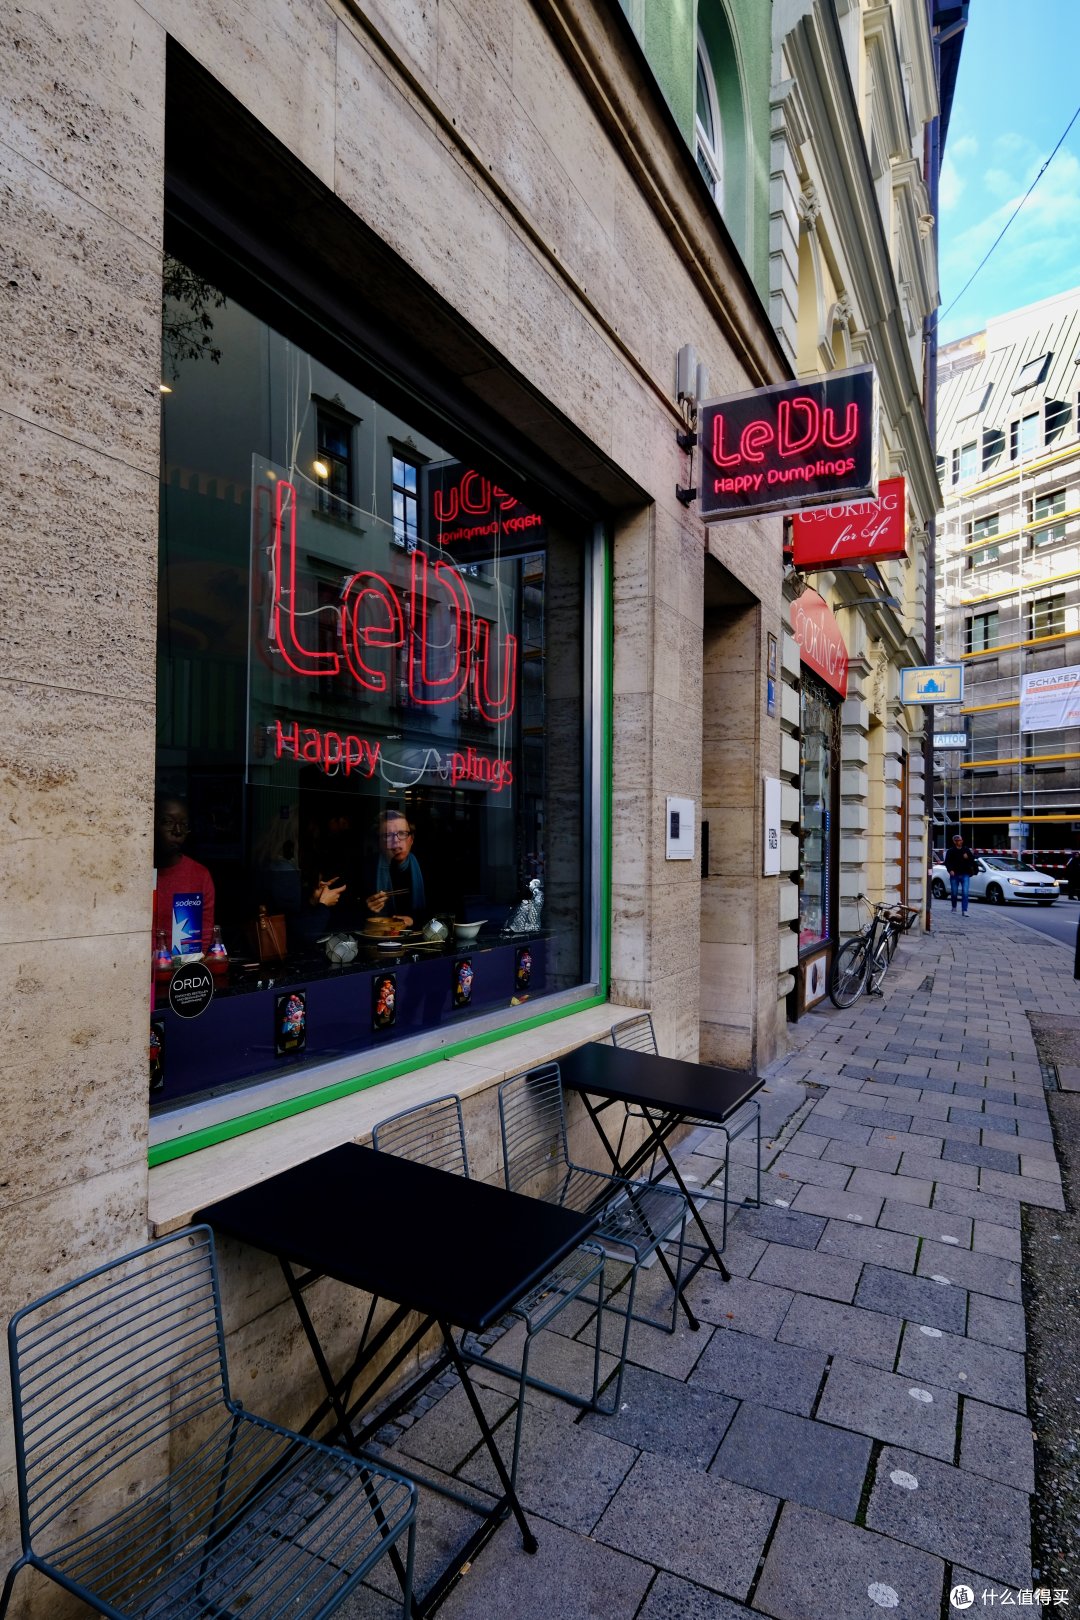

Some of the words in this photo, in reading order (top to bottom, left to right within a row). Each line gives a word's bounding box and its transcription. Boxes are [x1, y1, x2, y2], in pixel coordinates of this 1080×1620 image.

[713, 397, 858, 467] LeDu
[714, 473, 763, 494] Happy
[767, 458, 855, 485] Dumplings
[830, 524, 858, 555] for
[275, 480, 517, 722] LeDu
[275, 720, 380, 779] Happy
[933, 735, 965, 744] TATTOO
[175, 897, 202, 907] sodexo
